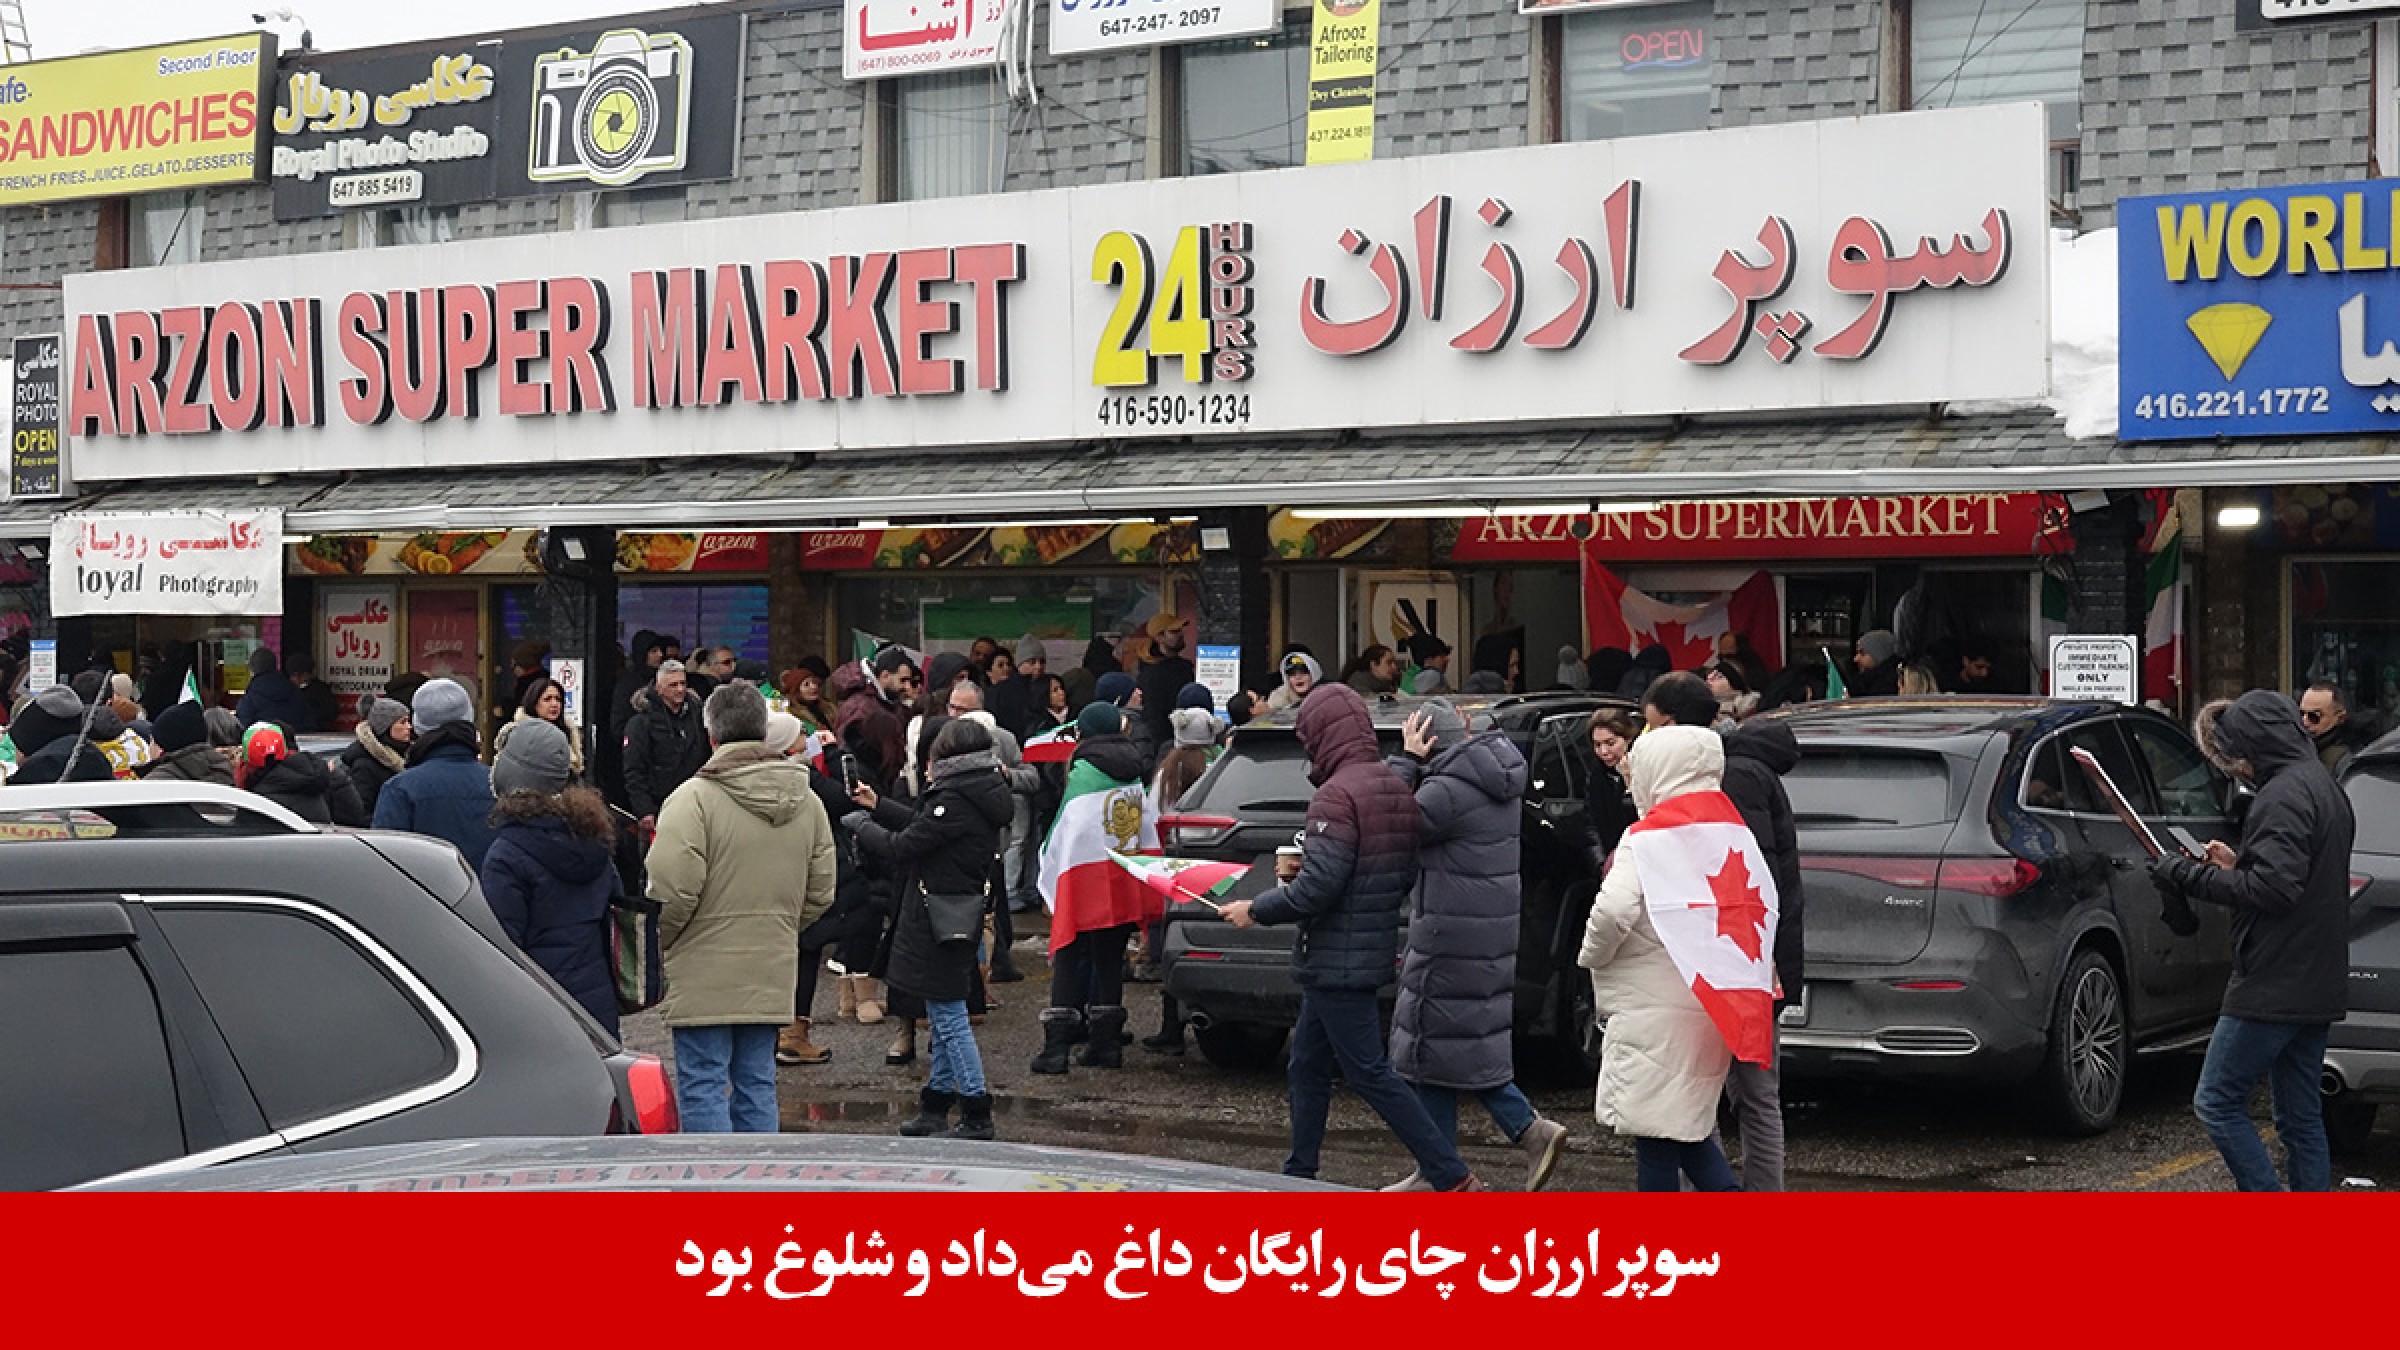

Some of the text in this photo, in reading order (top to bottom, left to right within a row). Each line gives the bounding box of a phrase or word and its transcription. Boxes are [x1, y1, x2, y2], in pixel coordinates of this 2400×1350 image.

[1179, 7, 1220, 27] 2097
[1318, 24, 1367, 44] Afrooz
[1622, 29, 1703, 62] OPEN
[157, 48, 257, 75] Second Floor
[1314, 42, 1375, 64] Tailoring
[375, 53, 494, 125] عکاسی
[1331, 86, 1374, 98] Cleaning
[272, 125, 488, 181] Royal Photo Studio
[2157, 189, 2400, 281] WORL
[1300, 180, 2011, 364] سوپر ارزان
[1092, 225, 1212, 389] 24
[1211, 222, 1256, 383] HOURS
[70, 243, 1026, 437] ARZON SUPER MARKET
[16, 381, 58, 402] ROYAL
[2135, 387, 2329, 419] 416.221.1772
[16, 403, 58, 423] PHOTO
[1097, 395, 1252, 428] 416-590-1234
[15, 429, 57, 452] OPEN
[1643, 494, 2010, 541] SUPERMARKET
[2077, 673, 2109, 682] ONLY
